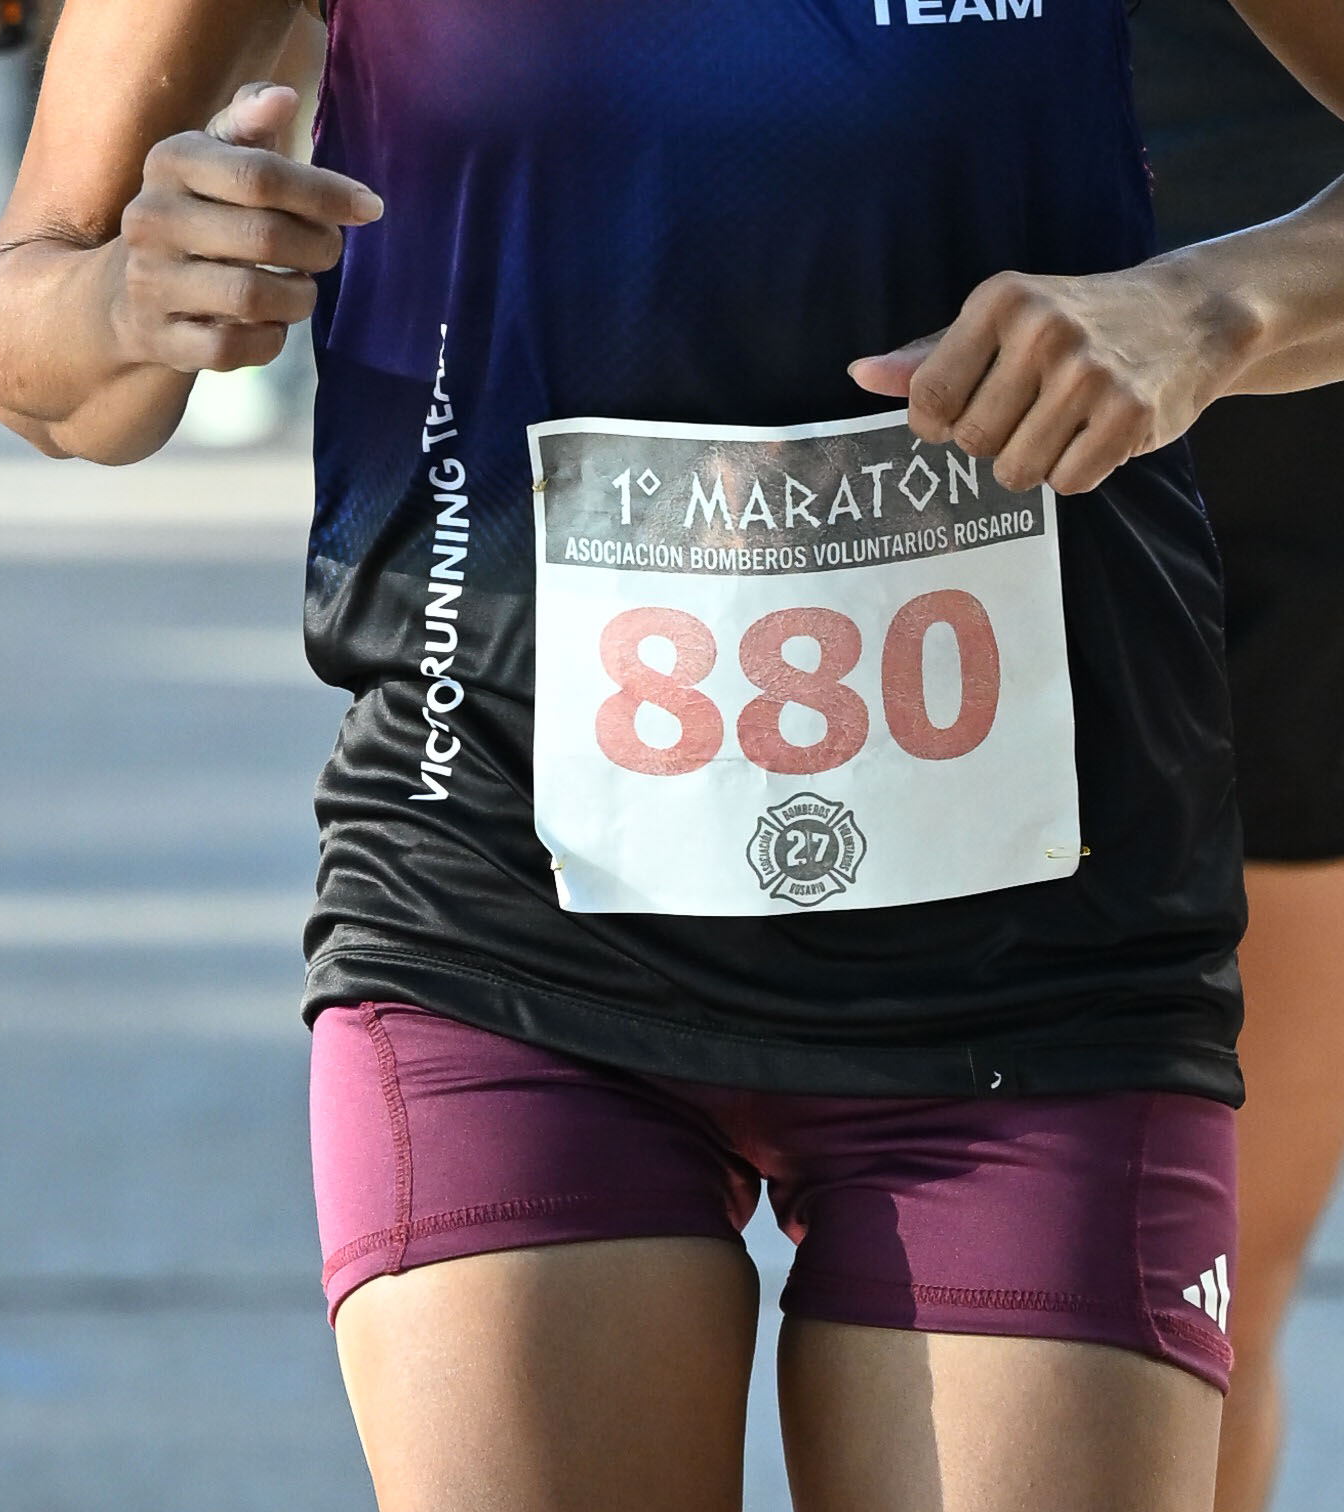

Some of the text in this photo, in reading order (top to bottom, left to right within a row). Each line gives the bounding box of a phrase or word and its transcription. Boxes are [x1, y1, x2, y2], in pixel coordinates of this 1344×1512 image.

[683, 438, 979, 531] MARATÓN
[408, 323, 469, 802] VICTORUNNING TEA
[565, 509, 1034, 570] ASOCIACIÓN BOMBEROS VOLUNTARIOS ROSARIO
[595, 588, 1001, 776] 880
[786, 829, 830, 867] 27
[788, 881, 826, 896] ROSARIO
